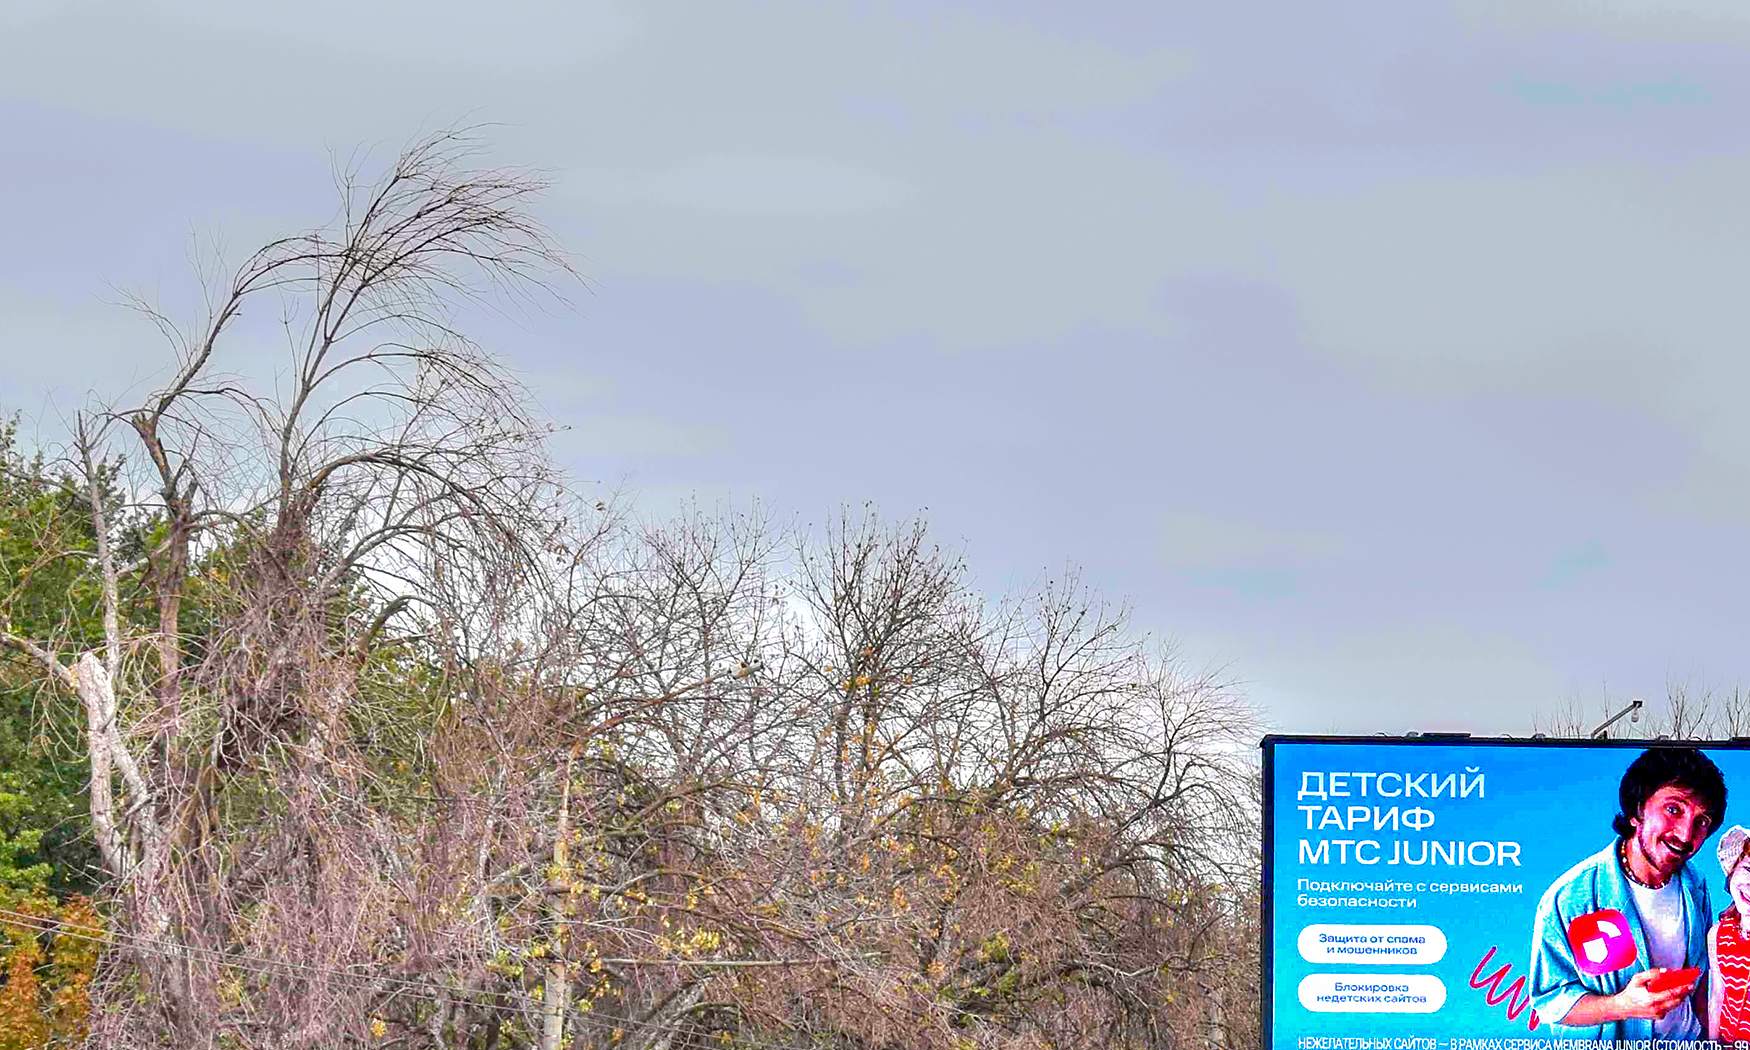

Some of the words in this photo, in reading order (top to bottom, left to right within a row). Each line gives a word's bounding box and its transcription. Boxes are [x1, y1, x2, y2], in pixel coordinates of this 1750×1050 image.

[1297, 766, 1486, 801] ДЕТСКИЙ
[1297, 805, 1436, 831] ТАРИФ
[1298, 839, 1381, 865] МТС
[1388, 840, 1522, 867] JUNIOR
[1297, 878, 1413, 894] Подключайте
[1416, 882, 1426, 893] с
[1428, 881, 1523, 896] сервисами
[1297, 894, 1417, 908] безопасности
[1319, 933, 1367, 945] Защита
[1370, 935, 1383, 944] от
[1387, 935, 1426, 945] спама
[1327, 946, 1335, 955] и
[1337, 946, 1418, 956] мошенников
[1334, 982, 1409, 994] Блокировка
[1316, 994, 1381, 1004] недетских
[1384, 992, 1427, 1005] сайтов
[1298, 1036, 1391, 1050] НЕЖЕЛАТЕЛЬНЫХ
[1394, 1034, 1437, 1050] САЙТОВ
[1450, 1038, 1459, 1050] В
[1460, 1038, 1502, 1050] РАМКАХ
[1504, 1038, 1551, 1050] СЕРВИСА
[1554, 1039, 1613, 1050] MEMBRANA
